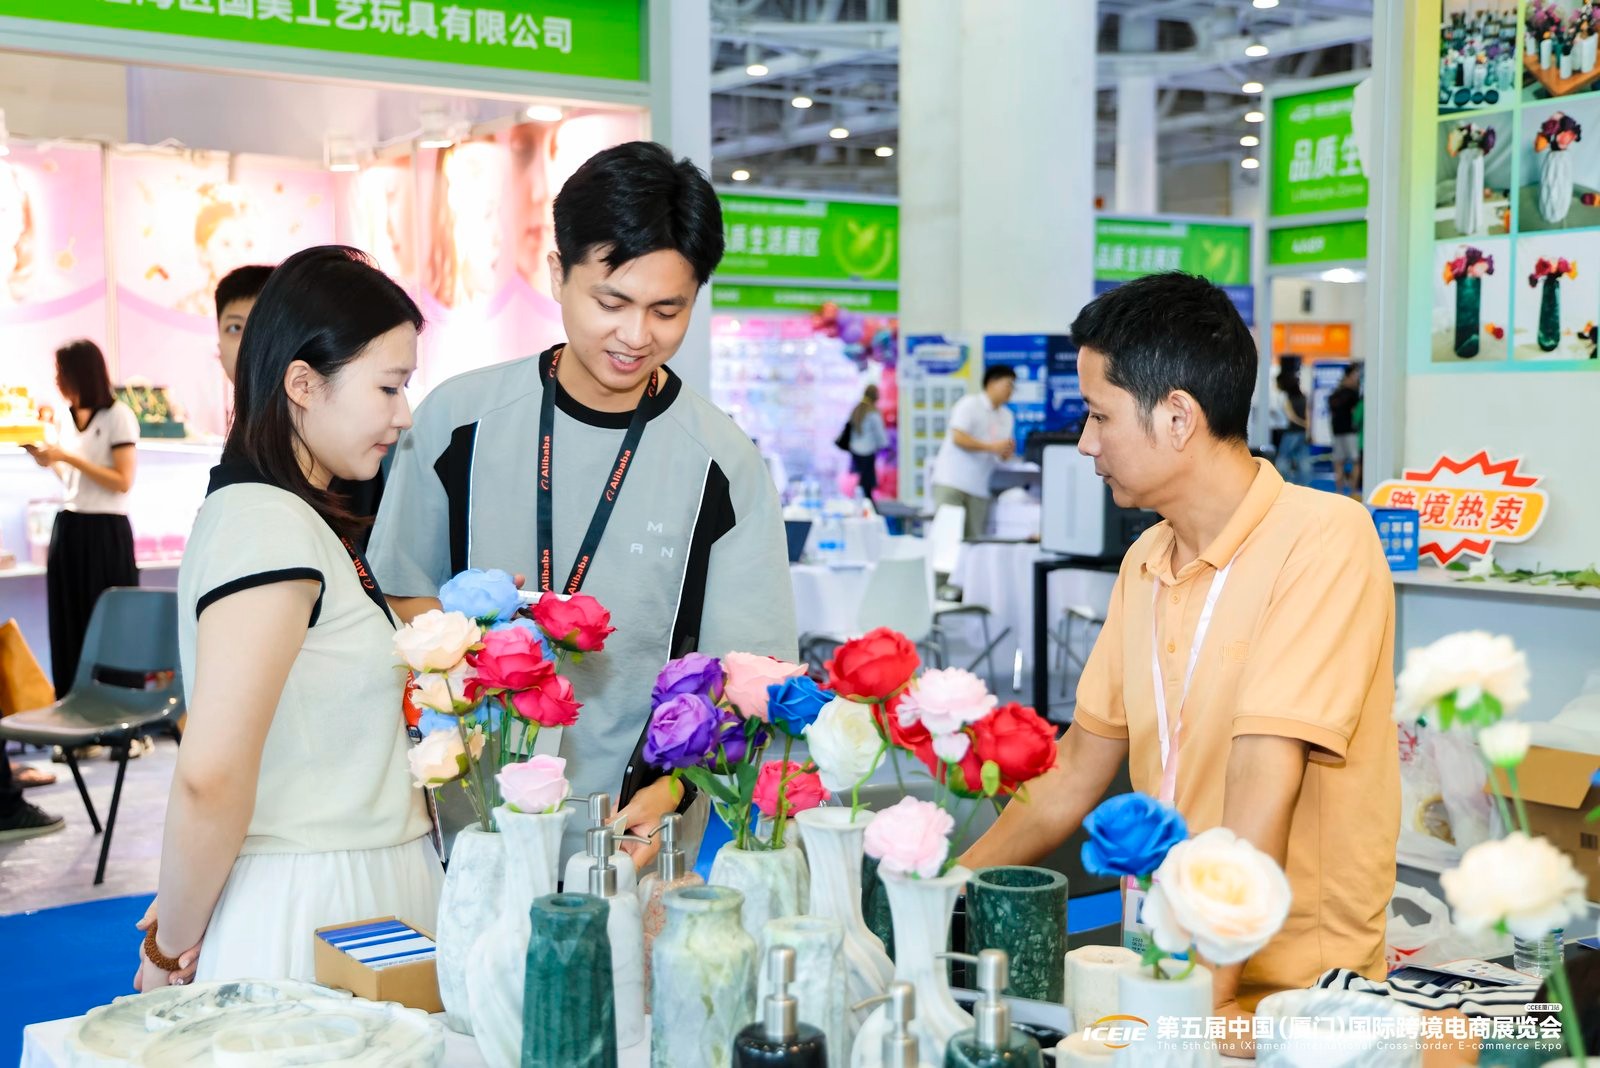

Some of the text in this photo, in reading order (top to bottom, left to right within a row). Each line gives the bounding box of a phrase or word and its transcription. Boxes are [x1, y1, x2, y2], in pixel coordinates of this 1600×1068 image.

[724, 223, 821, 257] 质生活展区
[540, 435, 550, 478] Alibaba
[609, 449, 631, 490] Alibaba
[541, 549, 550, 592] Alibaba
[568, 554, 589, 595] Alibaba
